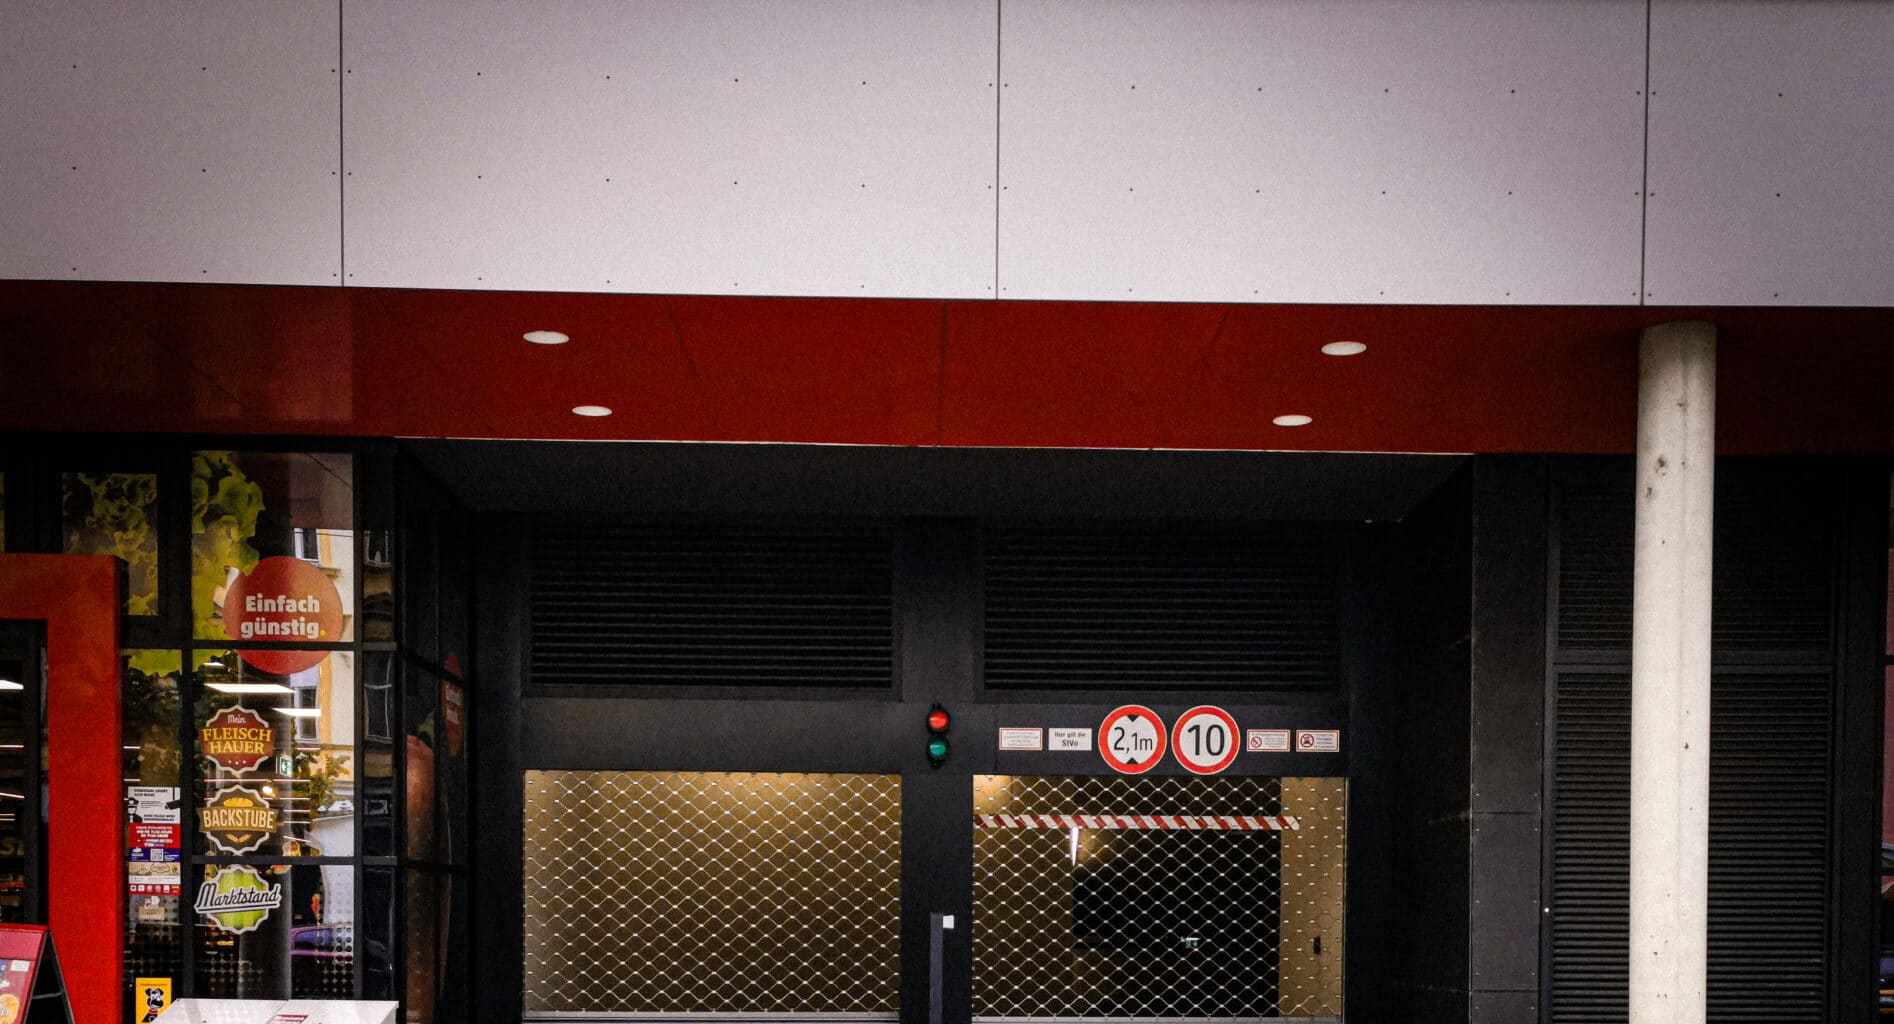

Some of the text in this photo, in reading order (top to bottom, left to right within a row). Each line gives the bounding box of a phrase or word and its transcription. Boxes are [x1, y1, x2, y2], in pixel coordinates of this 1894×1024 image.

[245, 592, 320, 613] Einfach
[240, 616, 327, 640] günstig.
[227, 714, 247, 724] Mein
[202, 727, 272, 742] FLEISCH
[1113, 726, 1153, 754] 2,1m
[1187, 724, 1225, 756] 10
[209, 741, 265, 755] HAUER
[203, 809, 275, 828] BACKSTUBE
[196, 882, 281, 908] Marktstand
